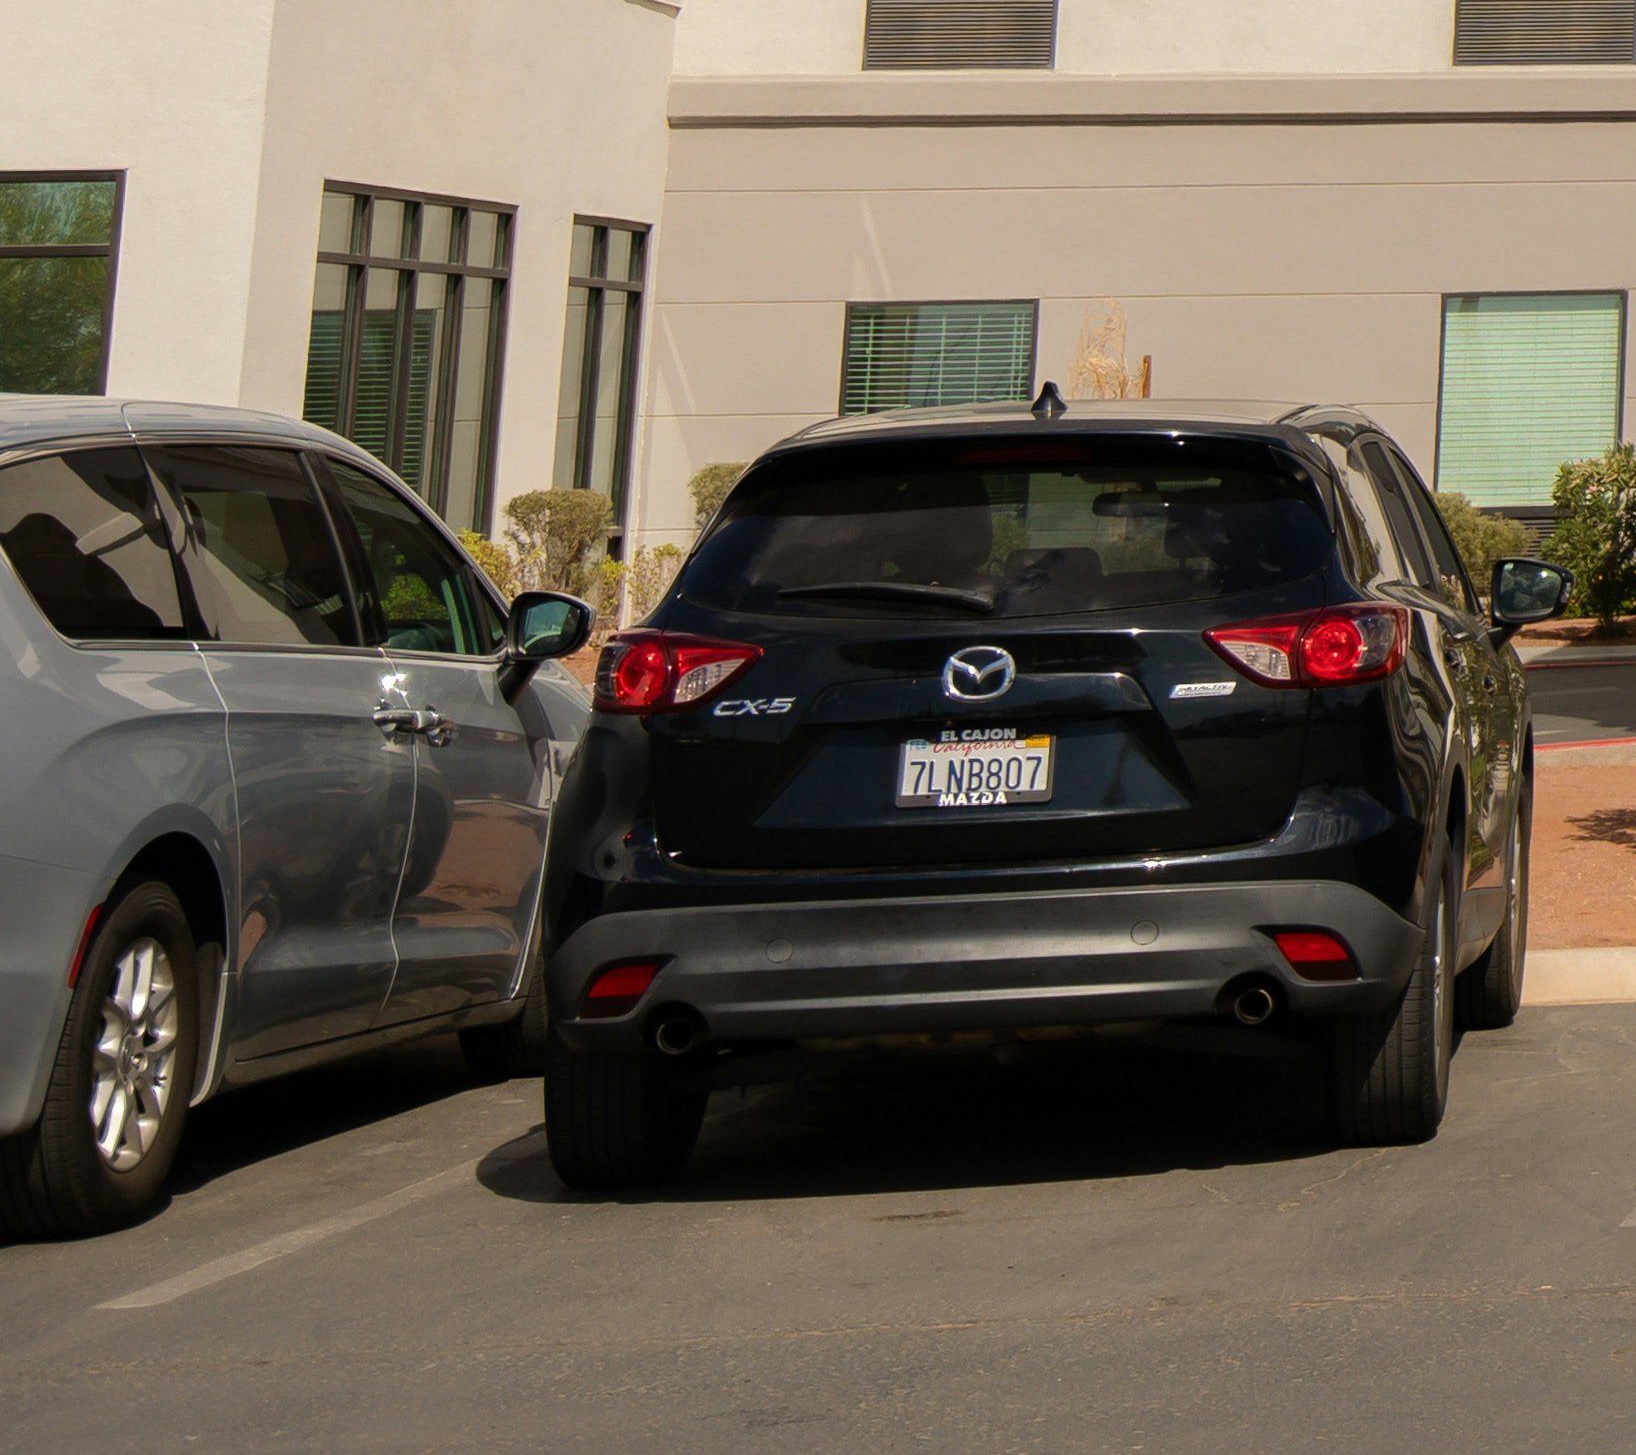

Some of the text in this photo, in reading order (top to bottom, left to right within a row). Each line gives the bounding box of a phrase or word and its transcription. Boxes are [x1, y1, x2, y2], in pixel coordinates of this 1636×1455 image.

[713, 697, 796, 716] CX-5
[941, 731, 958, 742] EL
[962, 728, 1016, 741] CAJON
[910, 756, 1042, 795] 7LNB807
[938, 791, 1007, 806] MAZDA
